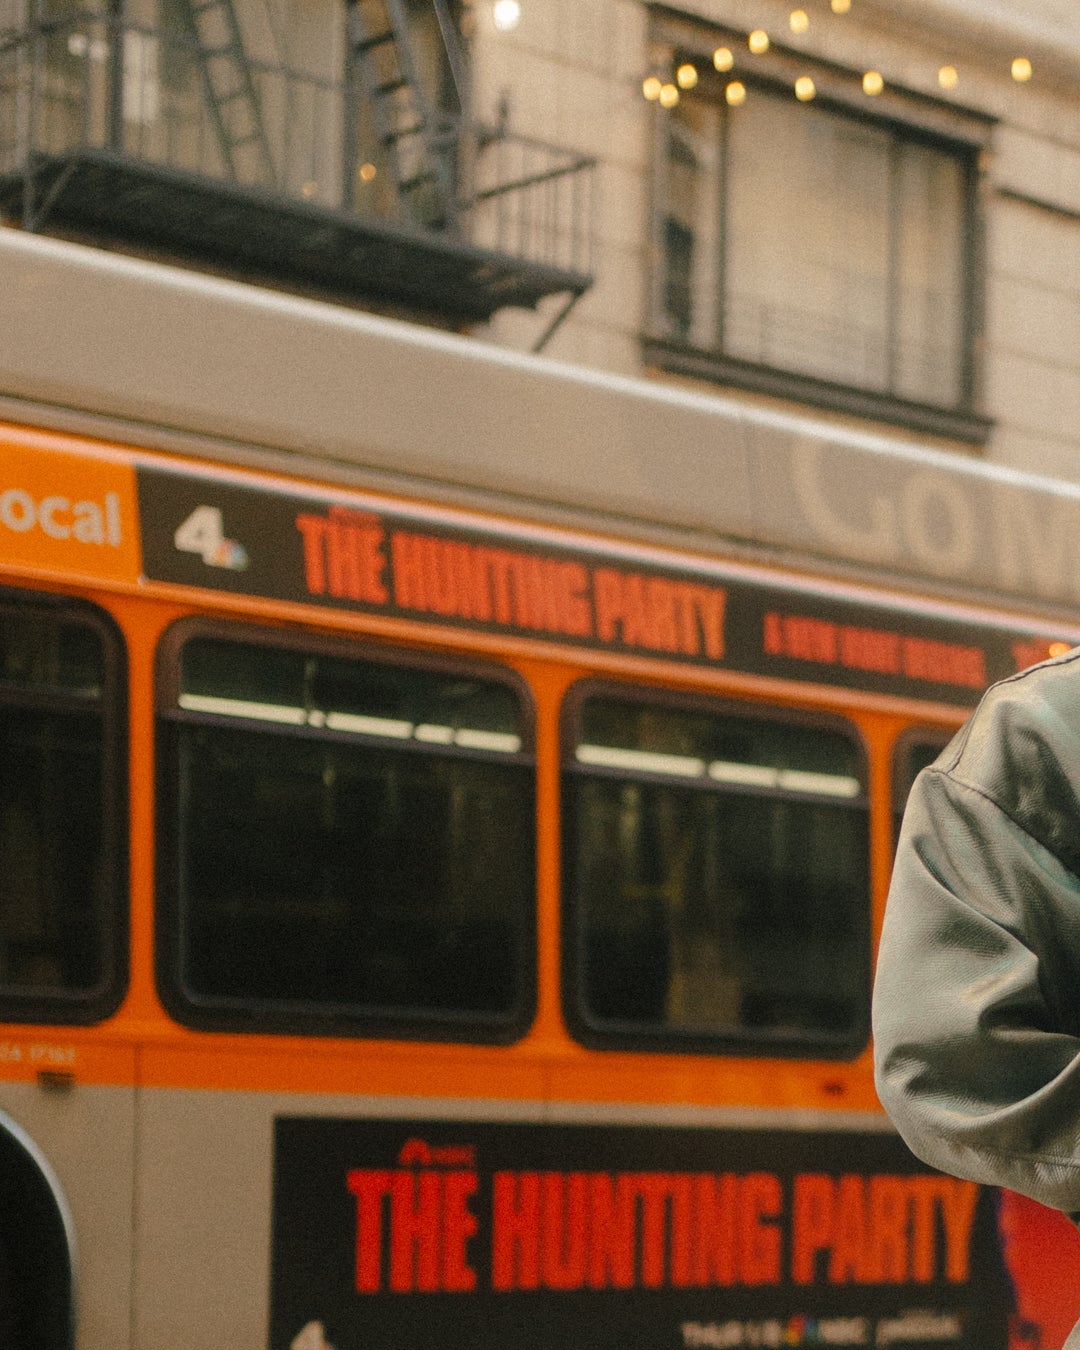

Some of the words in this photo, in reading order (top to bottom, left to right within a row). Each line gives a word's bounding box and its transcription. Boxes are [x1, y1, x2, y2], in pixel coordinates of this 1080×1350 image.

[174, 504, 224, 567] 4
[296, 512, 388, 604] THE
[392, 530, 592, 638] HUNTING
[594, 566, 727, 660] PARTY
[347, 1168, 478, 1293] THE
[492, 1170, 782, 1291] HUNTING
[792, 1172, 979, 1285] PARTY
